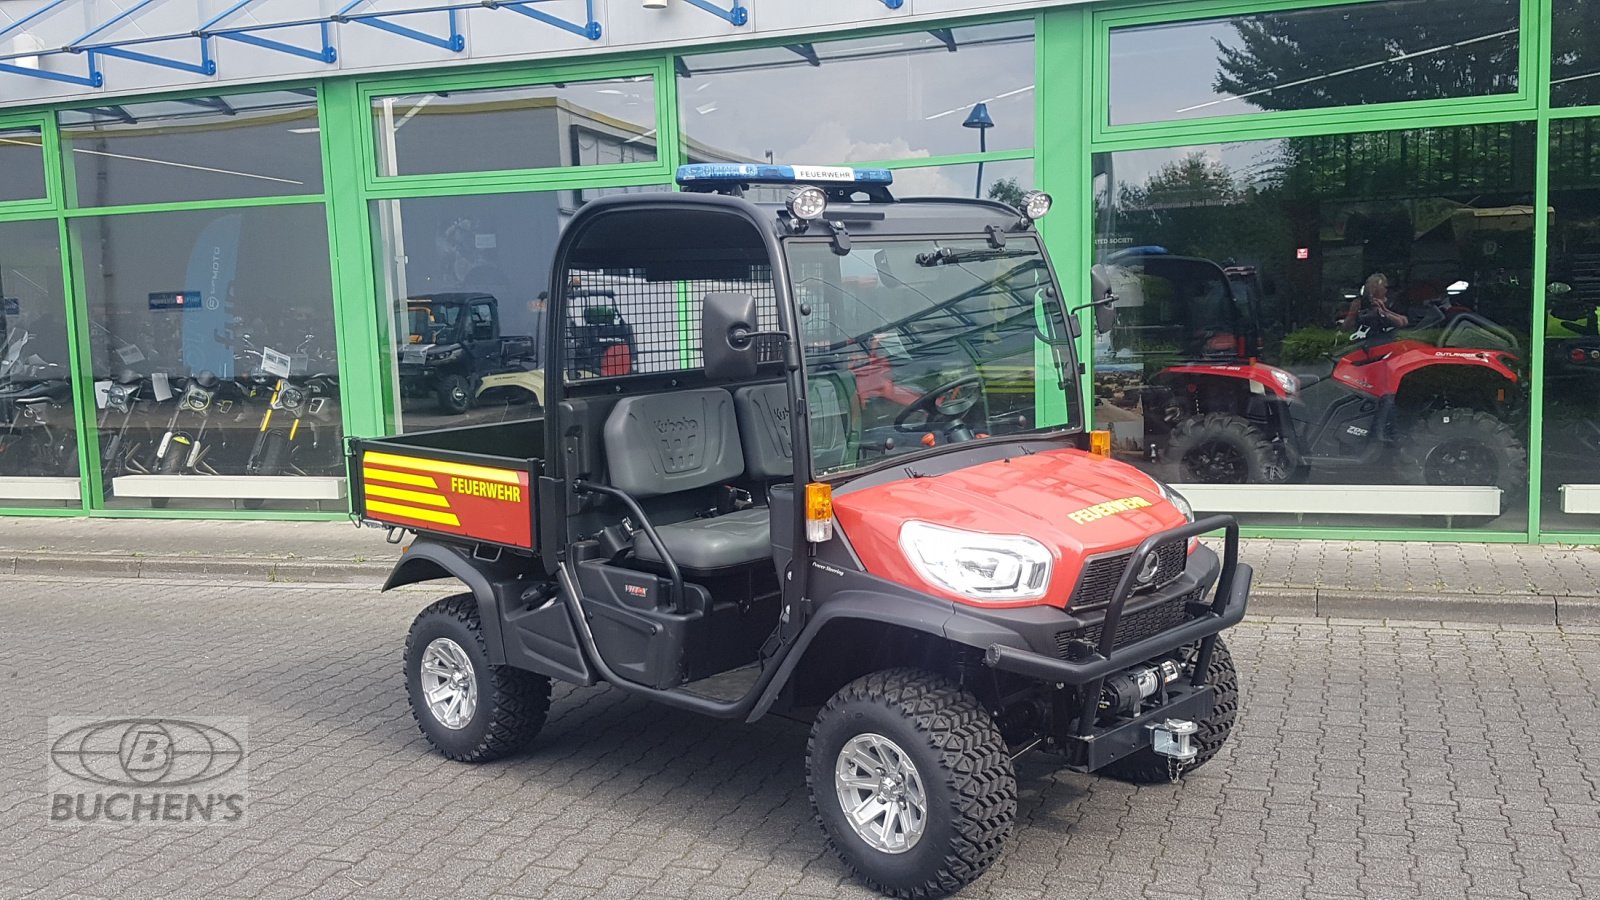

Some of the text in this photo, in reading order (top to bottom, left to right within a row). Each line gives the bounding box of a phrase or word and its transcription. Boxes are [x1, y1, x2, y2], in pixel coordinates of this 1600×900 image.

[800, 171, 851, 179] FEUERWEHR
[653, 416, 698, 433] Kubota
[451, 477, 521, 503] FEUERWEHR
[1066, 496, 1153, 525] FEUERWEHR
